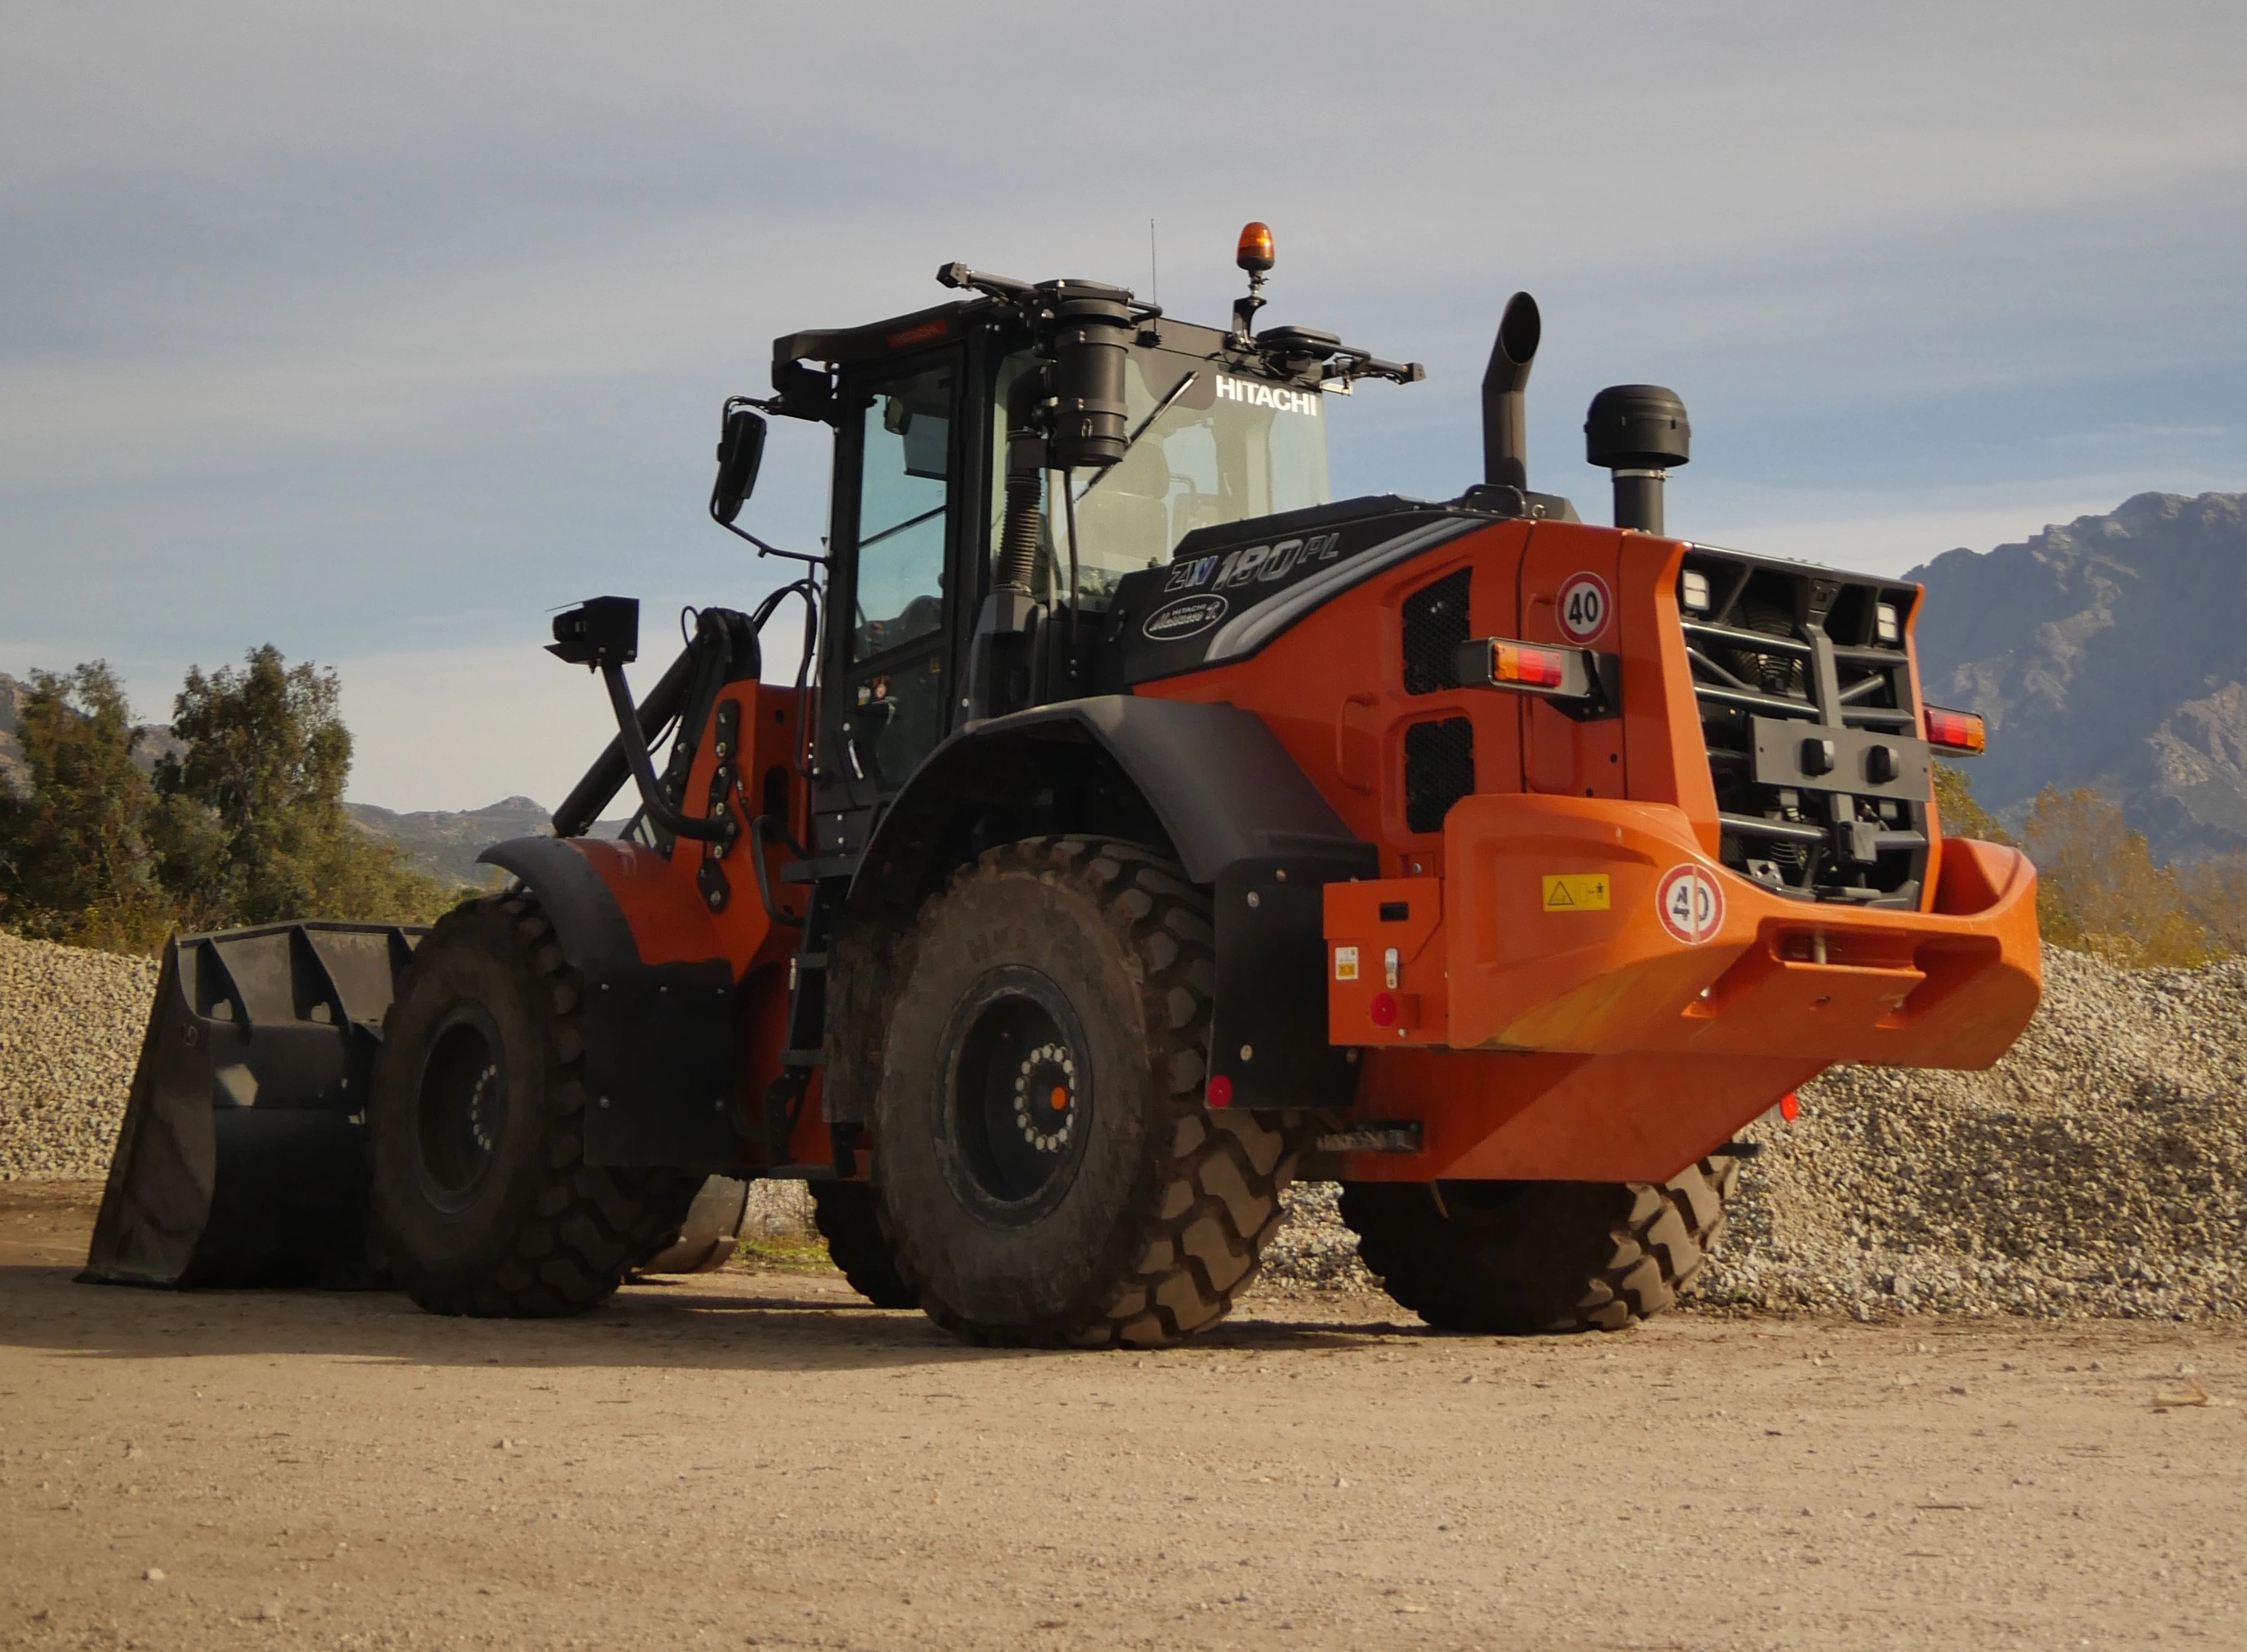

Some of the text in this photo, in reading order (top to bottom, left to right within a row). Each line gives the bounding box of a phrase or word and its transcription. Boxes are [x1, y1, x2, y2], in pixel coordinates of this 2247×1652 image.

[1215, 374, 1317, 416] HITACHI
[1171, 603, 1208, 616] HITACHI
[1568, 591, 1599, 625] 40
[1673, 885, 1710, 921] 40
